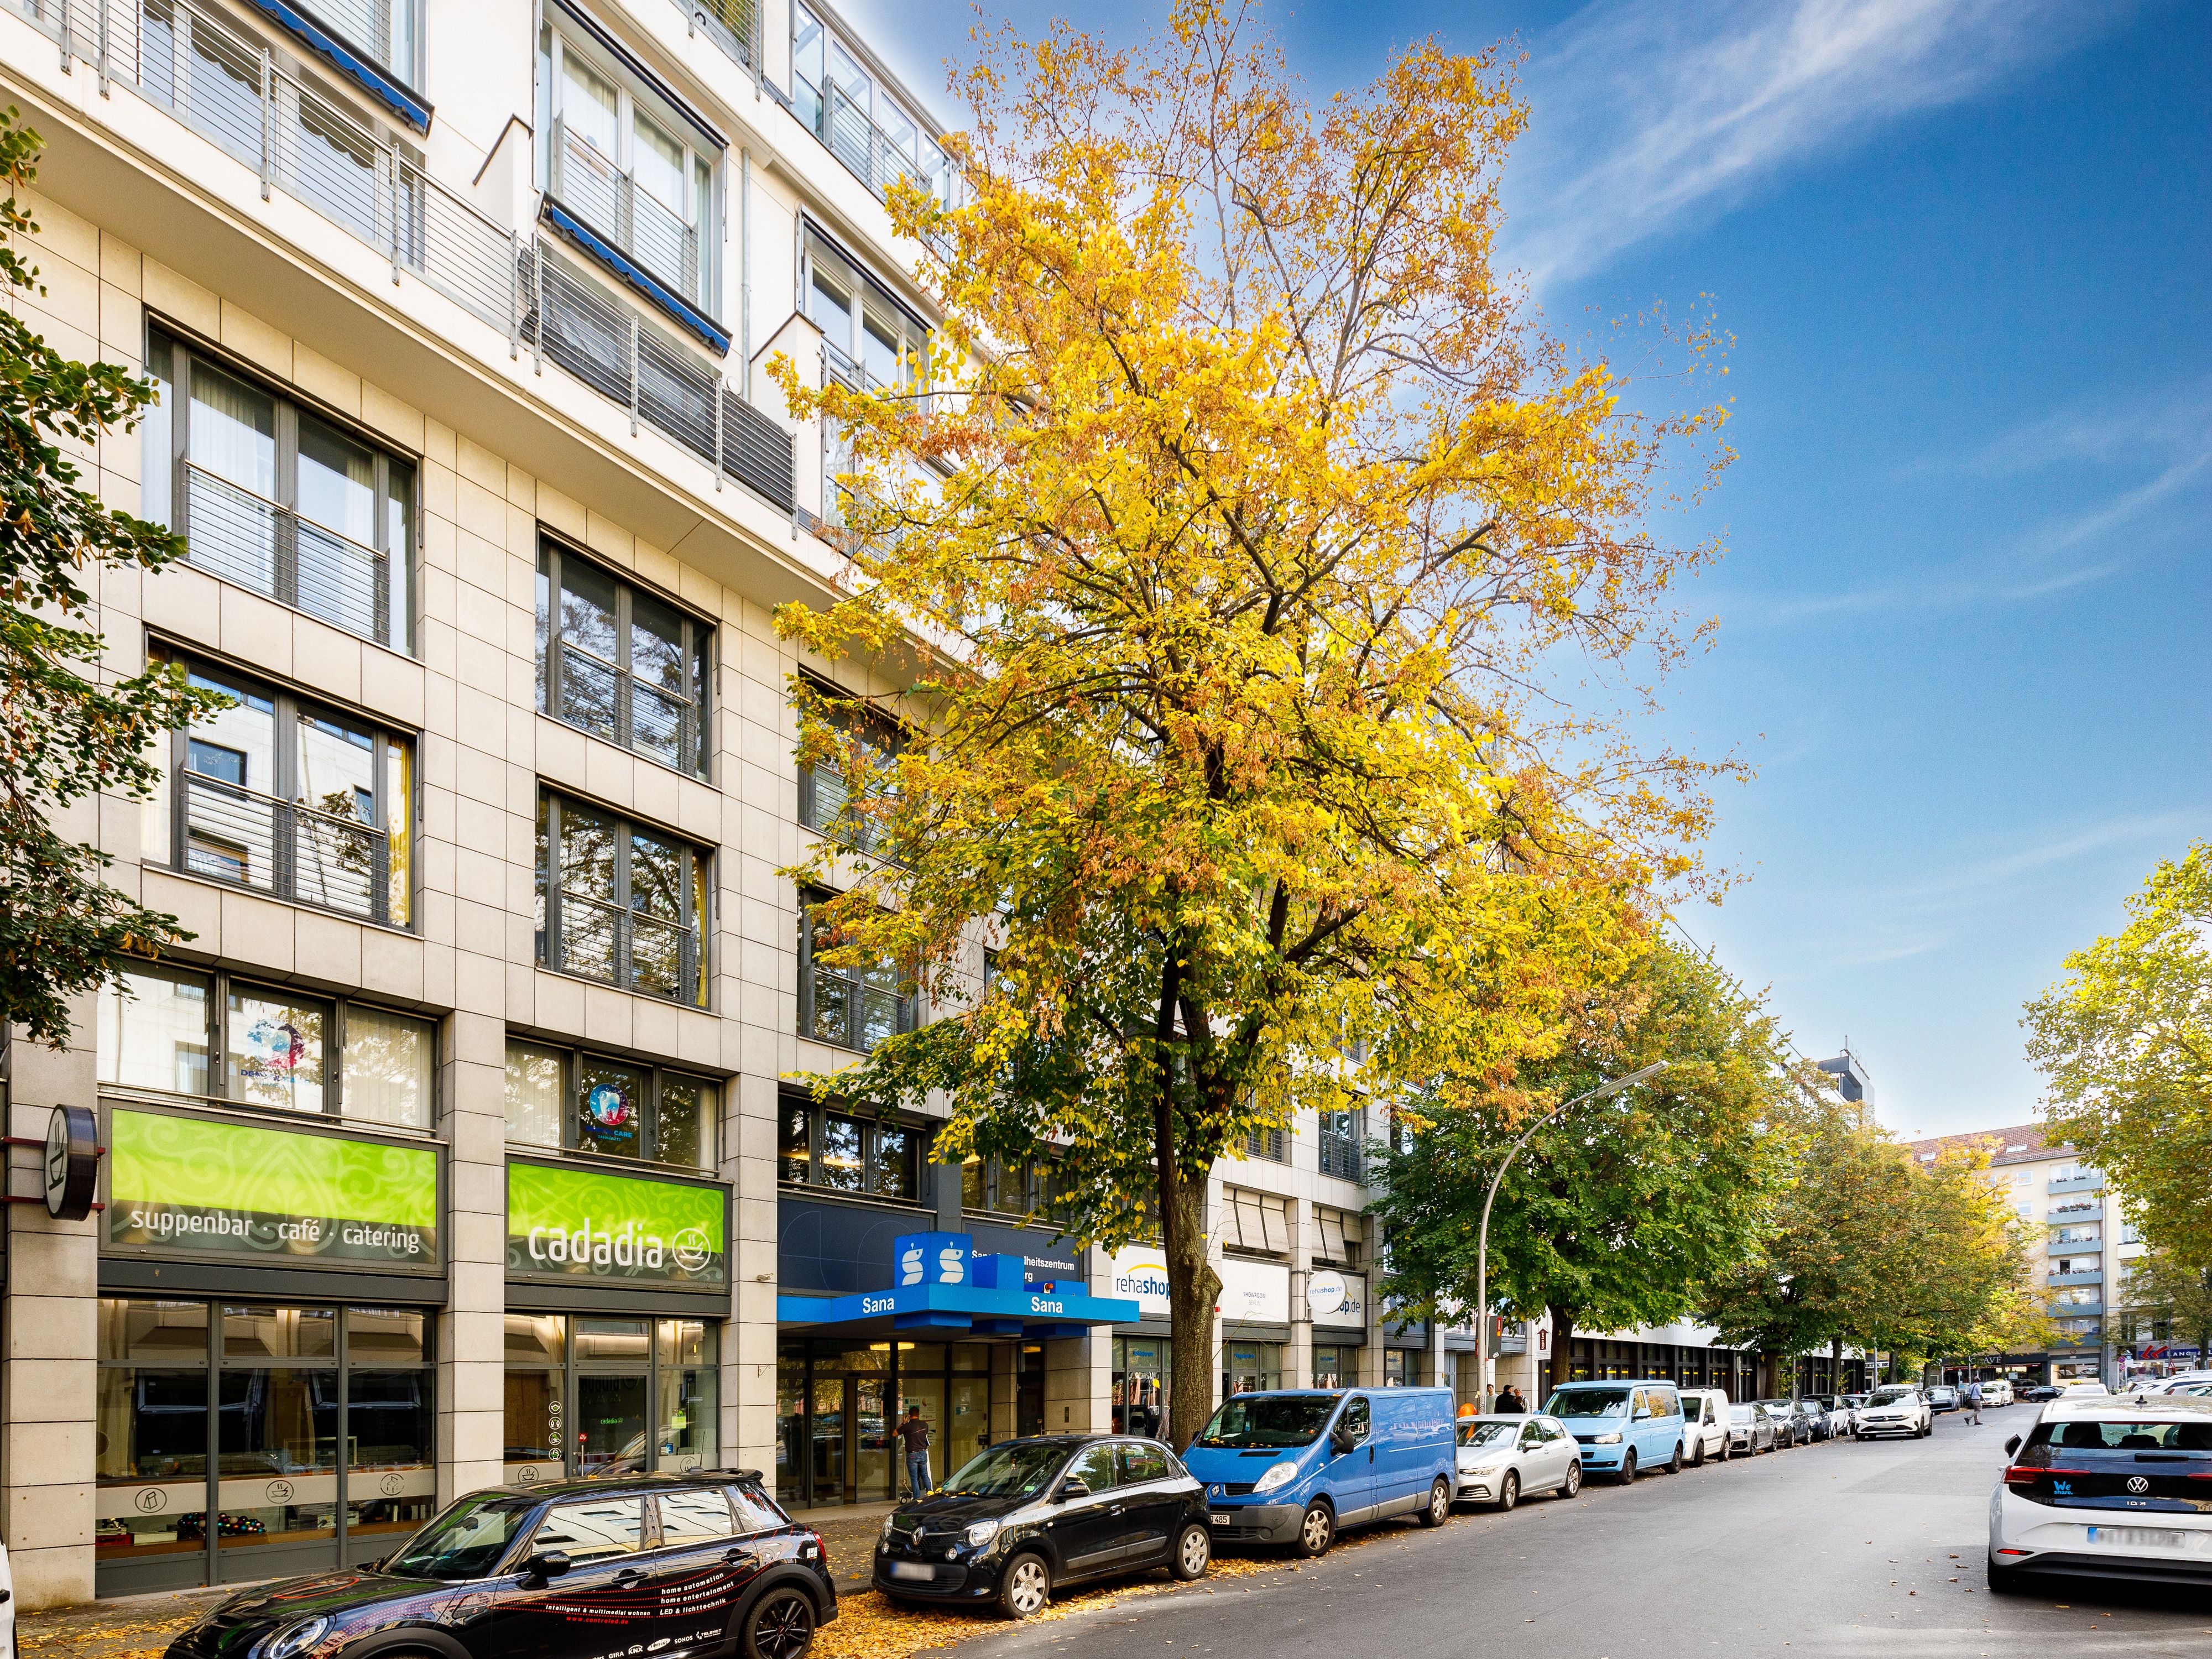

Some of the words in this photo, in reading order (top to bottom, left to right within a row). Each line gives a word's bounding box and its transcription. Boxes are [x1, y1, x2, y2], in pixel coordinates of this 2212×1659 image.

[614, 1130, 633, 1138] CARE
[131, 1211, 253, 1236] suppenbar
[279, 1219, 320, 1241] café
[343, 1225, 419, 1253] catering
[529, 1218, 662, 1268] cadadia
[1310, 1286, 1342, 1295] rehashop.de
[863, 1297, 894, 1313] Sana
[1031, 1296, 1063, 1313] Sana
[2053, 1480, 2071, 1491] We
[1214, 1515, 1227, 1524] 485
[684, 1573, 724, 1590] automation
[683, 1581, 734, 1601] entertainment
[683, 1598, 726, 1613] lichttechnik
[608, 1651, 624, 1659] GIRA
[674, 1635, 693, 1644] SONOS
